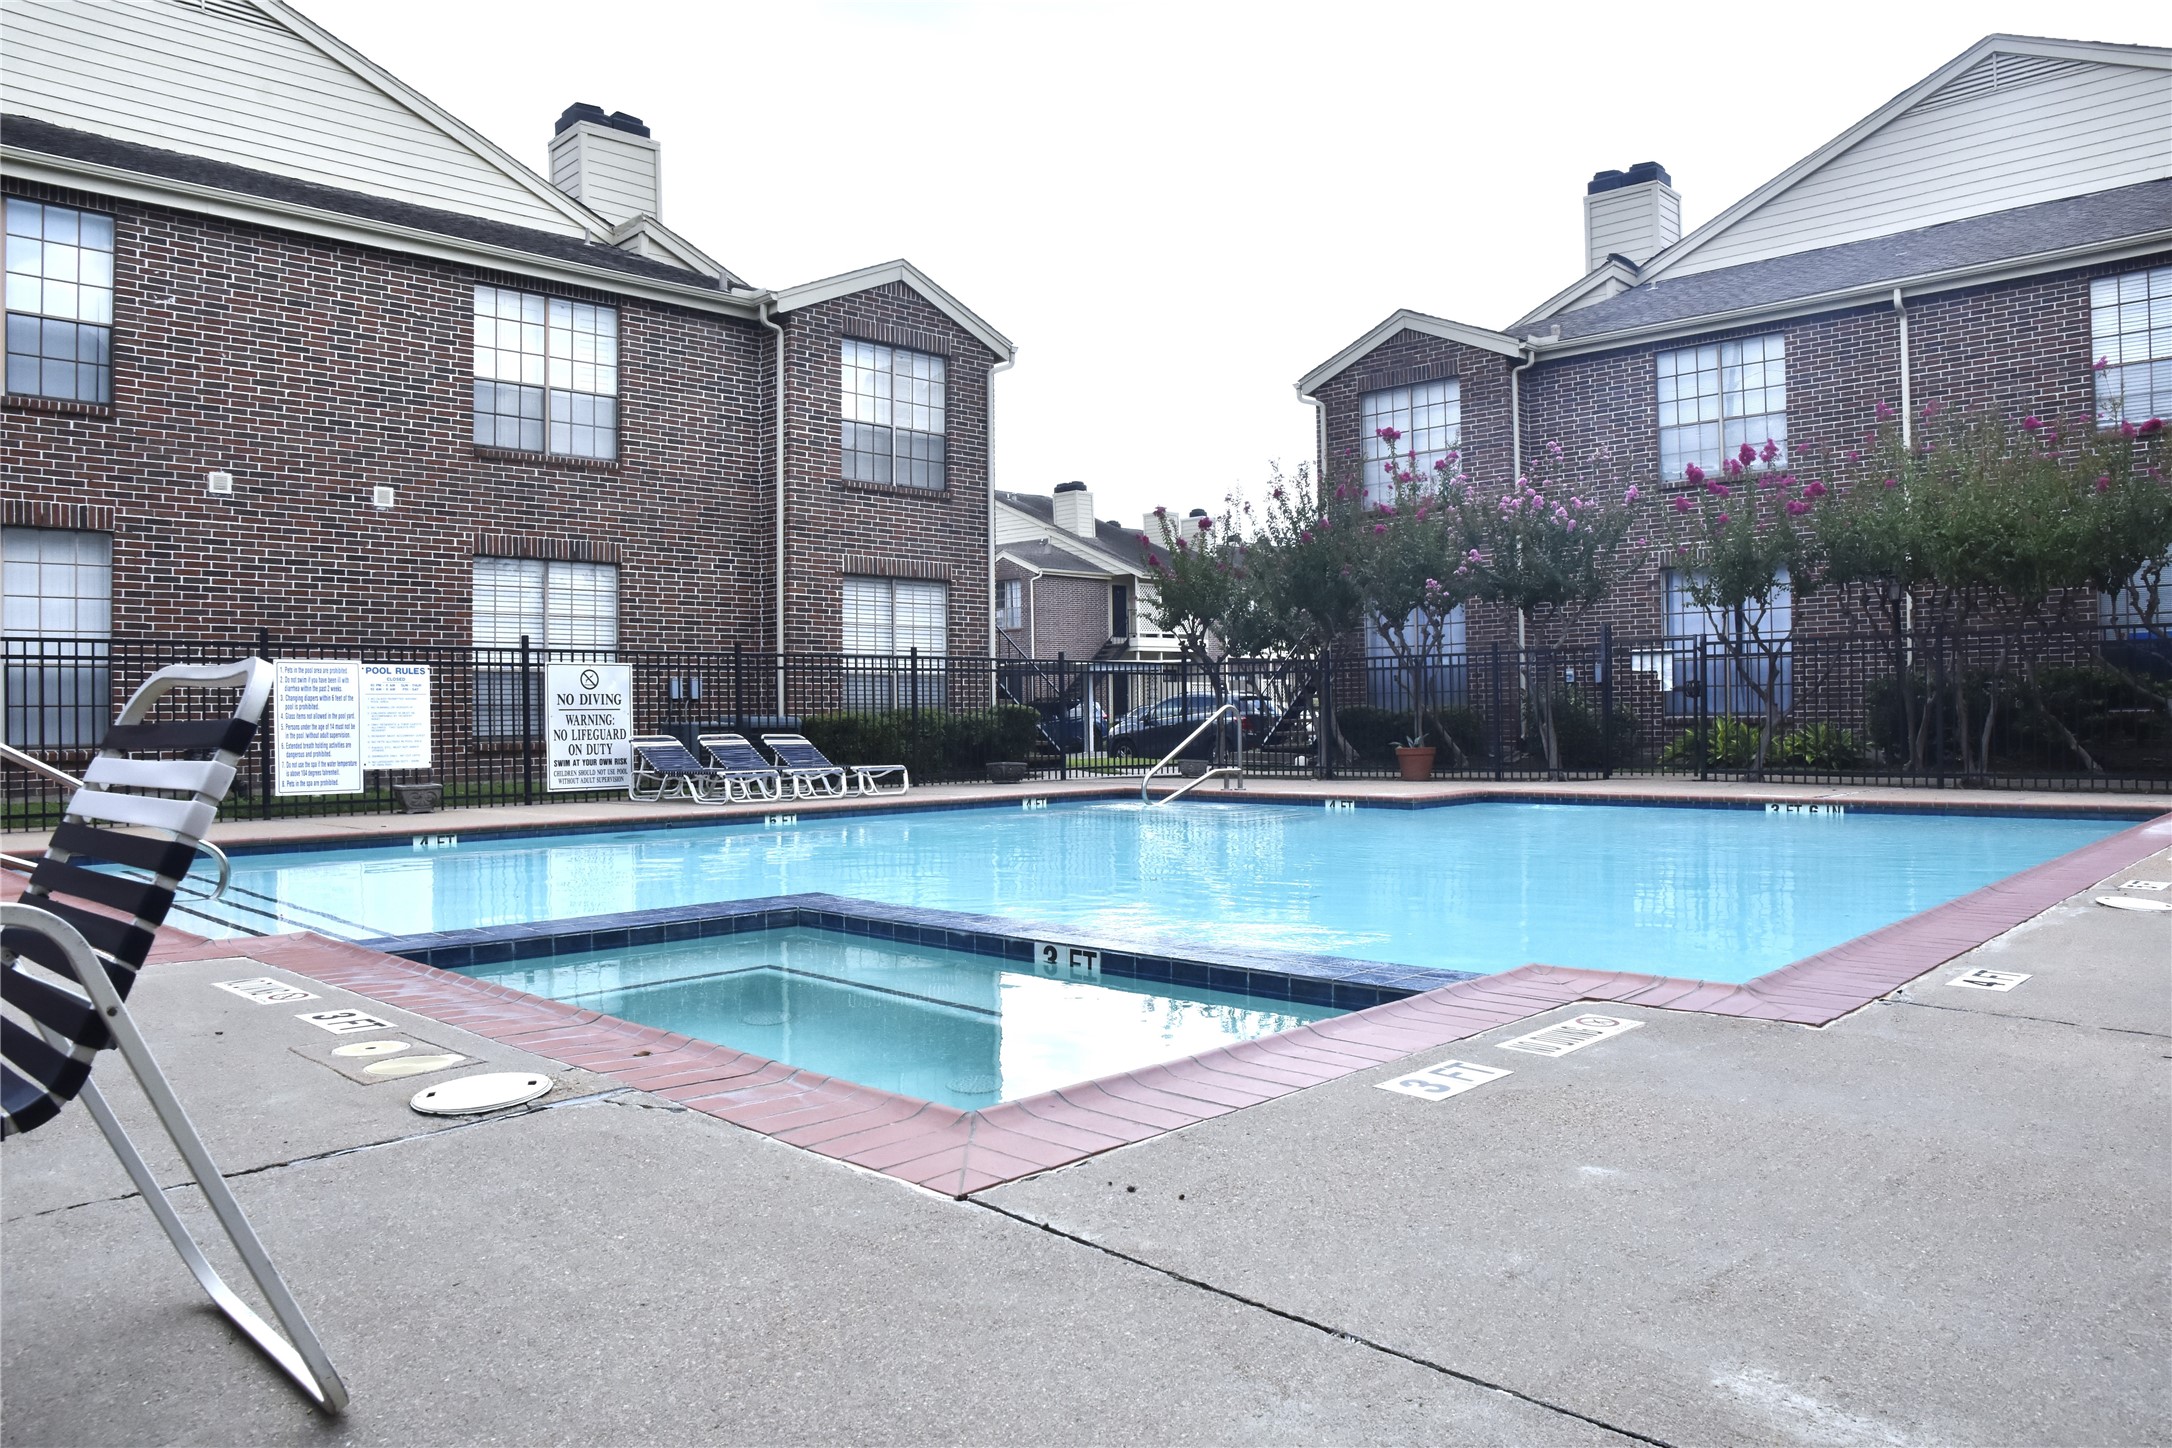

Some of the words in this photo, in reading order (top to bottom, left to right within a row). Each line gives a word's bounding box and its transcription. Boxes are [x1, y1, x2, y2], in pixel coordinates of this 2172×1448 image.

[557, 694, 574, 705] NO
[580, 694, 622, 705] DIVING
[566, 714, 614, 725] WARNING:
[554, 729, 567, 741] NO
[572, 729, 626, 740] LIFEGUARD
[568, 744, 582, 756] ON
[586, 744, 612, 756] DUTY
[437, 834, 455, 843] FT
[1043, 945, 1058, 964] 3
[1070, 948, 1097, 970] FT
[1972, 970, 2021, 981] FT
[327, 1019, 387, 1030] FT
[1399, 1079, 1451, 1093] 3
[1428, 1062, 1495, 1082] FT
